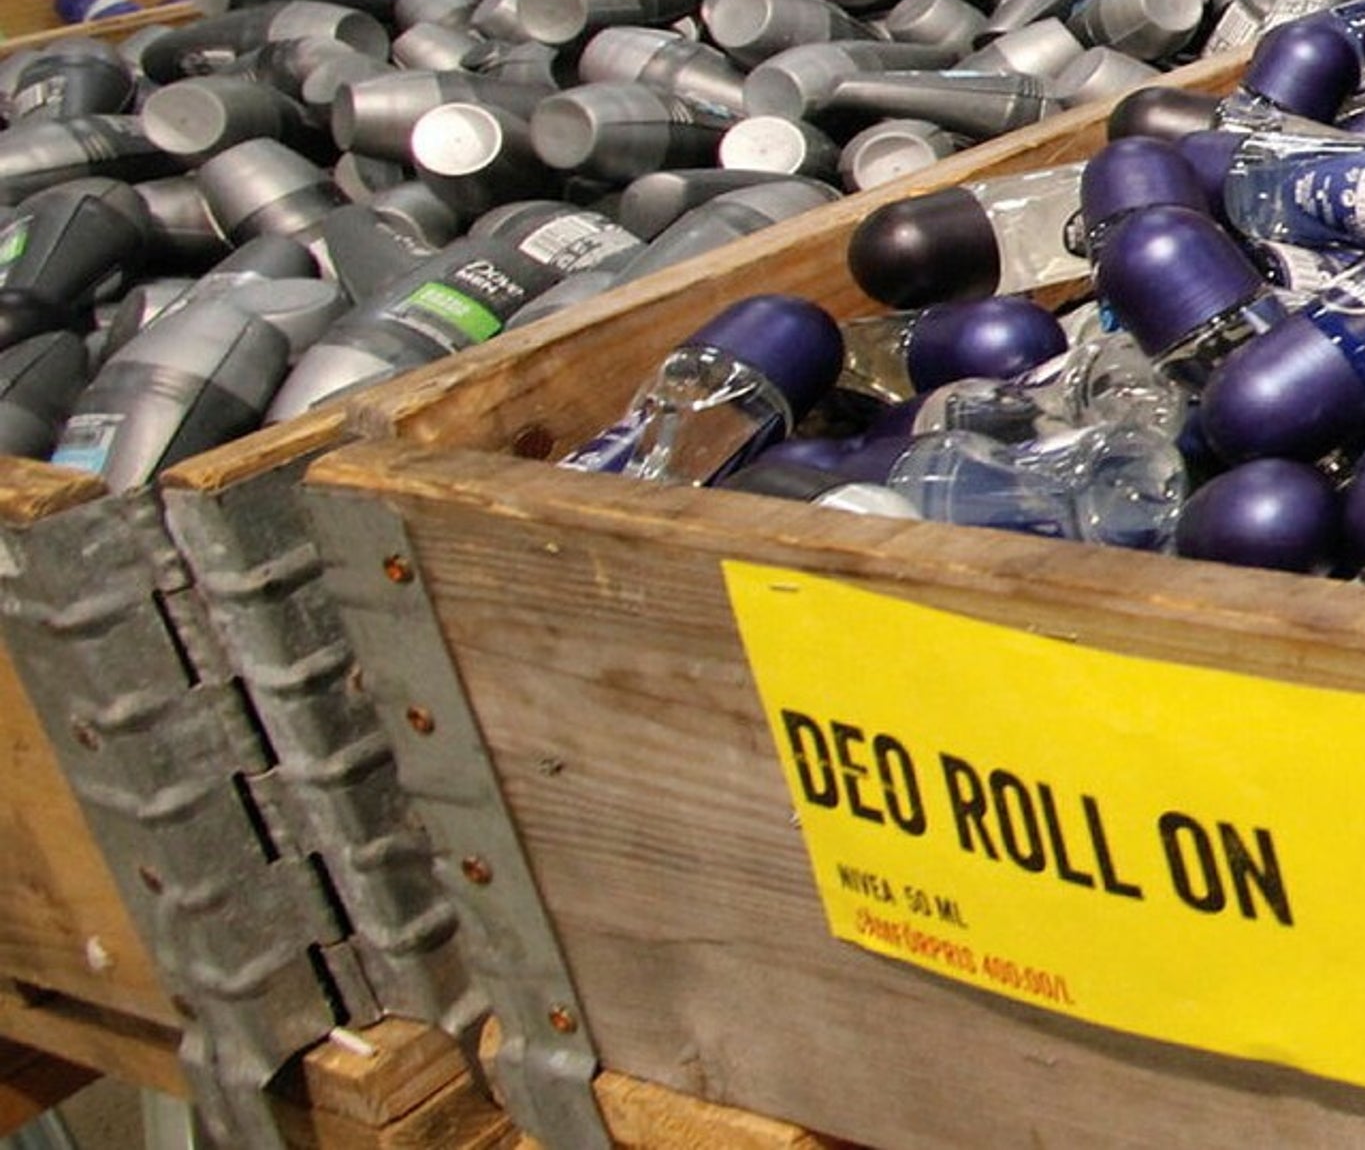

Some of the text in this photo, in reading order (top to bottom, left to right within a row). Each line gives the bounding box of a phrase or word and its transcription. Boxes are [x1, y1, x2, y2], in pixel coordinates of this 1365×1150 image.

[455, 269, 497, 294] MEN
[462, 259, 526, 297] Dove
[781, 708, 1294, 927] DEO ROLL ON
[837, 863, 969, 930] NIVEA 50 ML
